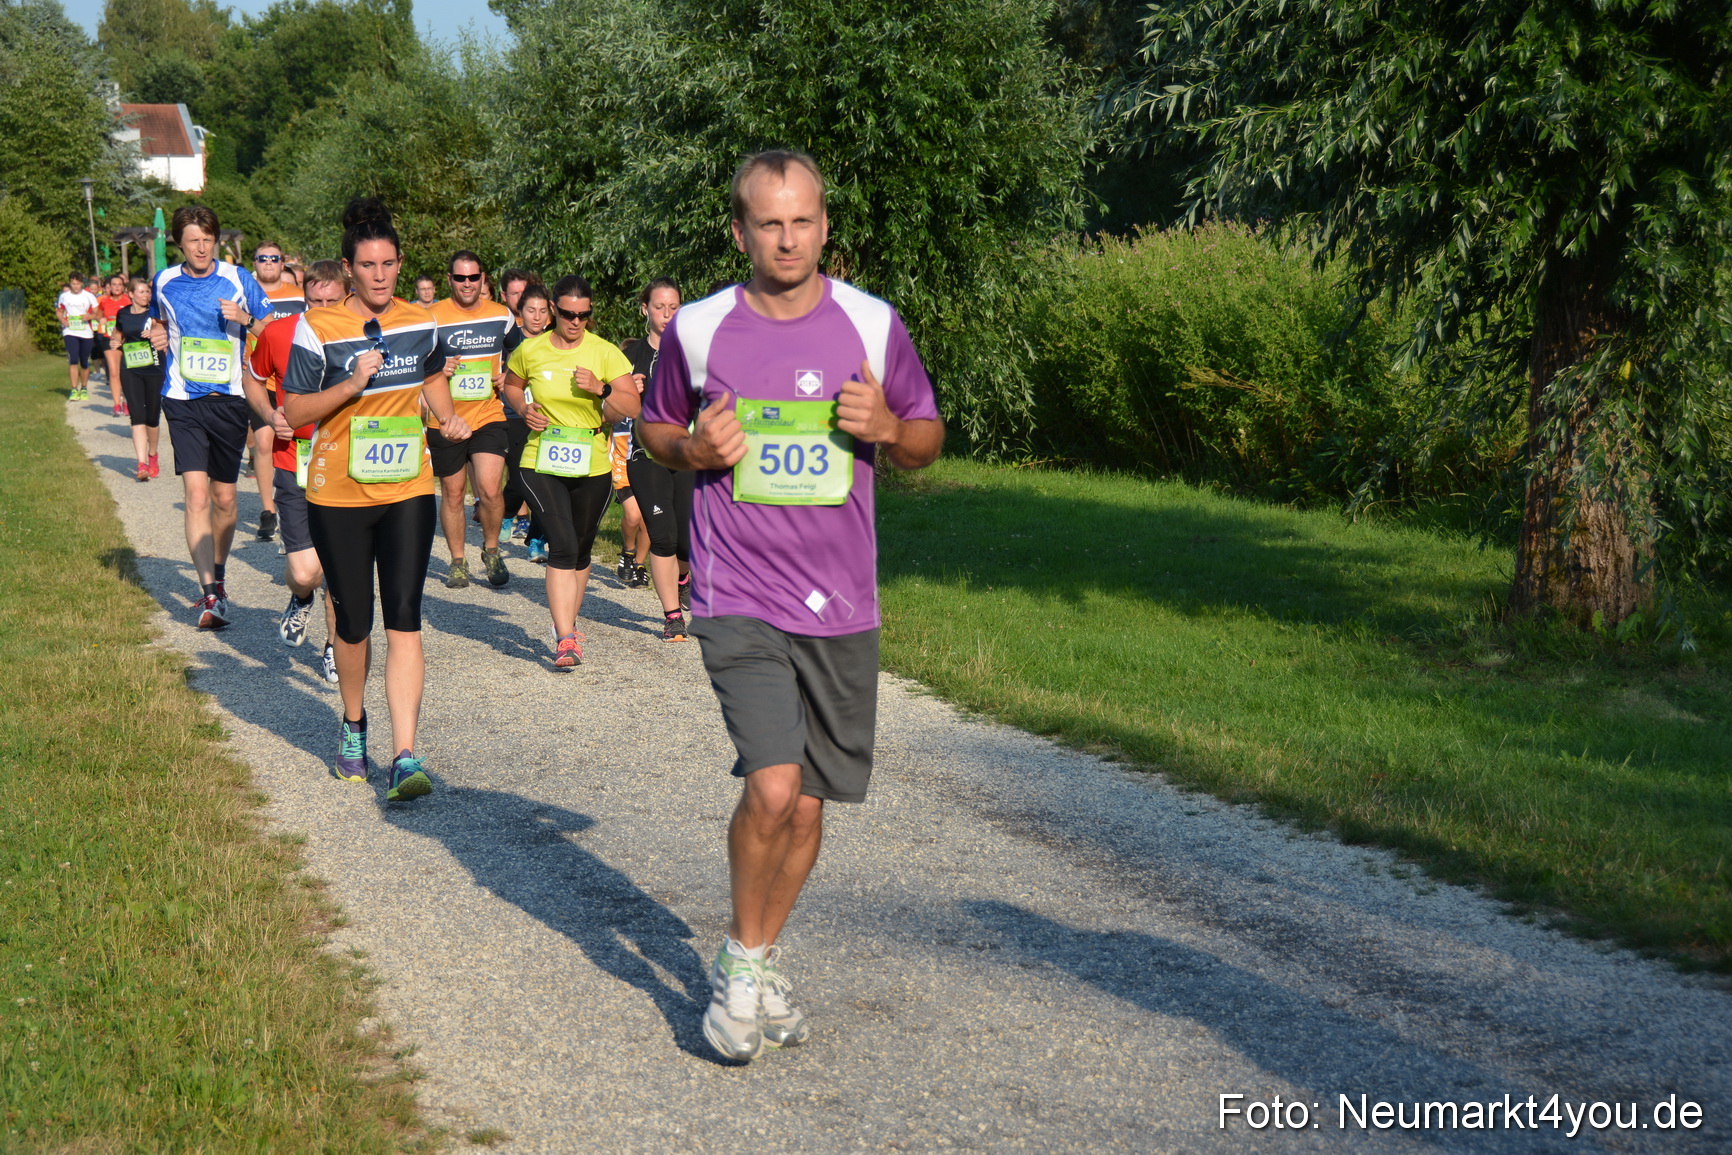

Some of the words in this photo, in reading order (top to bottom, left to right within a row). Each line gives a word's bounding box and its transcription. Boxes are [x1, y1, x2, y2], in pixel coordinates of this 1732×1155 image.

[457, 330, 497, 346] Fischer
[127, 350, 149, 361] 1130
[187, 355, 227, 372] 1125
[458, 377, 485, 390] 432
[364, 443, 409, 465] 407
[548, 445, 582, 464] 639
[759, 443, 829, 476] 503
